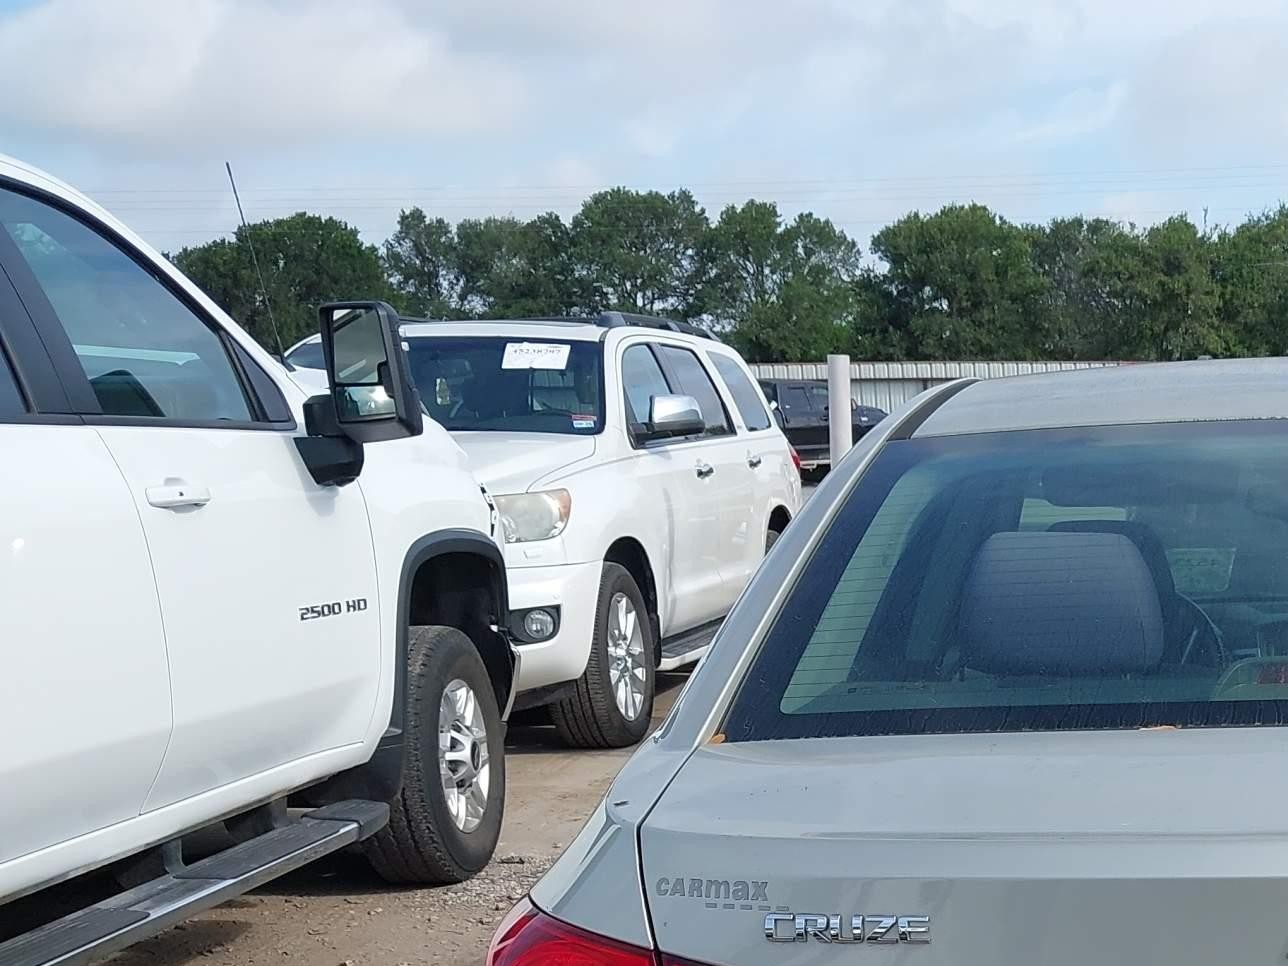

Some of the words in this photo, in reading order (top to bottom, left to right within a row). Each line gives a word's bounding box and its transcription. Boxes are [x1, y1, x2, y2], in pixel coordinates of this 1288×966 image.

[299, 602, 342, 621] 2500
[345, 598, 367, 613] HD
[764, 912, 931, 945] CRUZE
